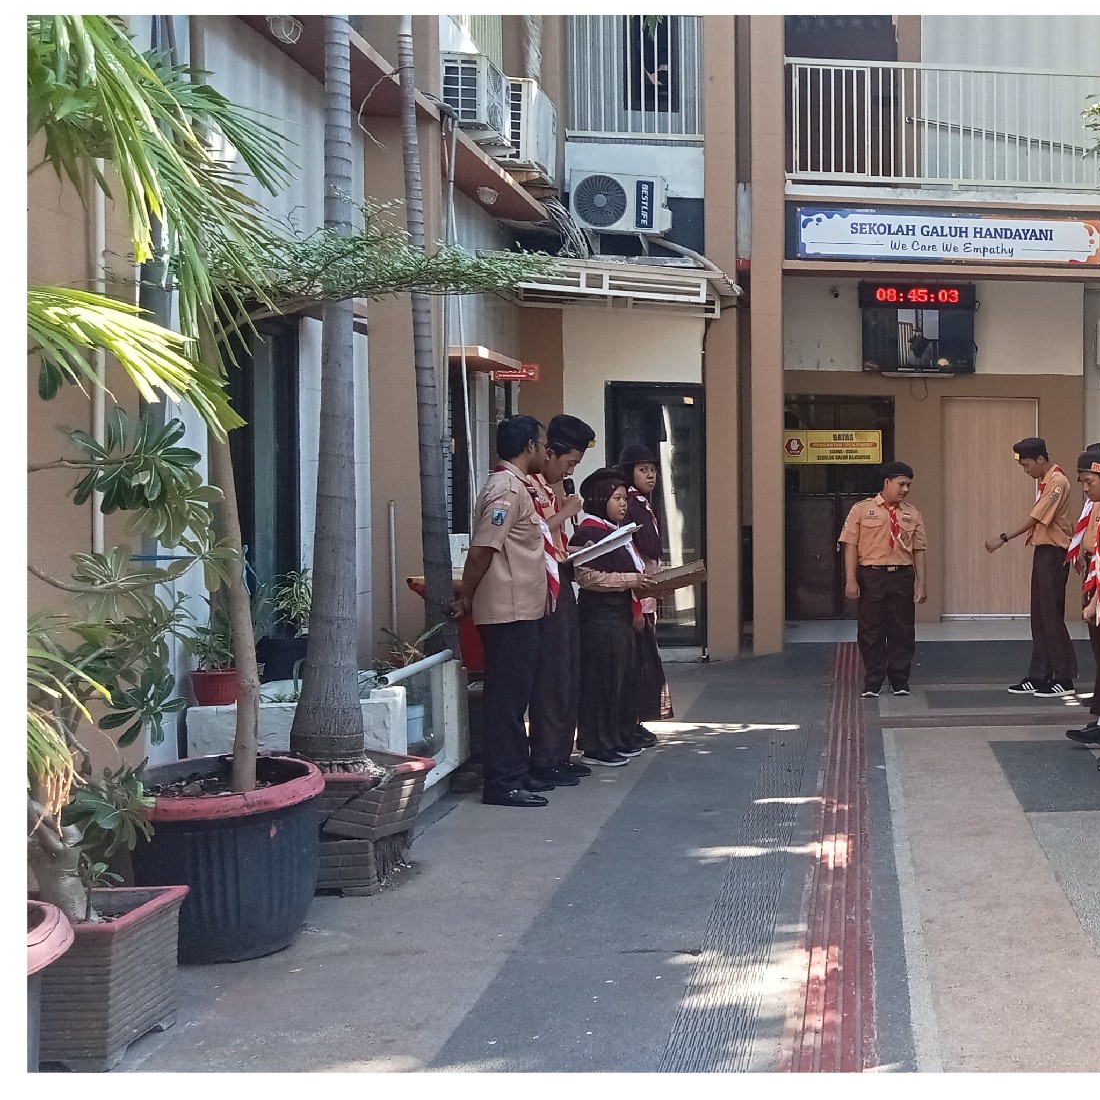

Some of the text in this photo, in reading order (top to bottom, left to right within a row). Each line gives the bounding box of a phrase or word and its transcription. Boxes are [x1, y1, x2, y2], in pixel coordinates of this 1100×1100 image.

[641, 184, 649, 226] BESTLIFE
[850, 222, 1054, 241] SEKOLAH GALUH HANDAYANI
[890, 240, 1014, 257] We Care We Empathy
[876, 288, 959, 303] 08:45:03
[833, 433, 854, 441] BATAS
